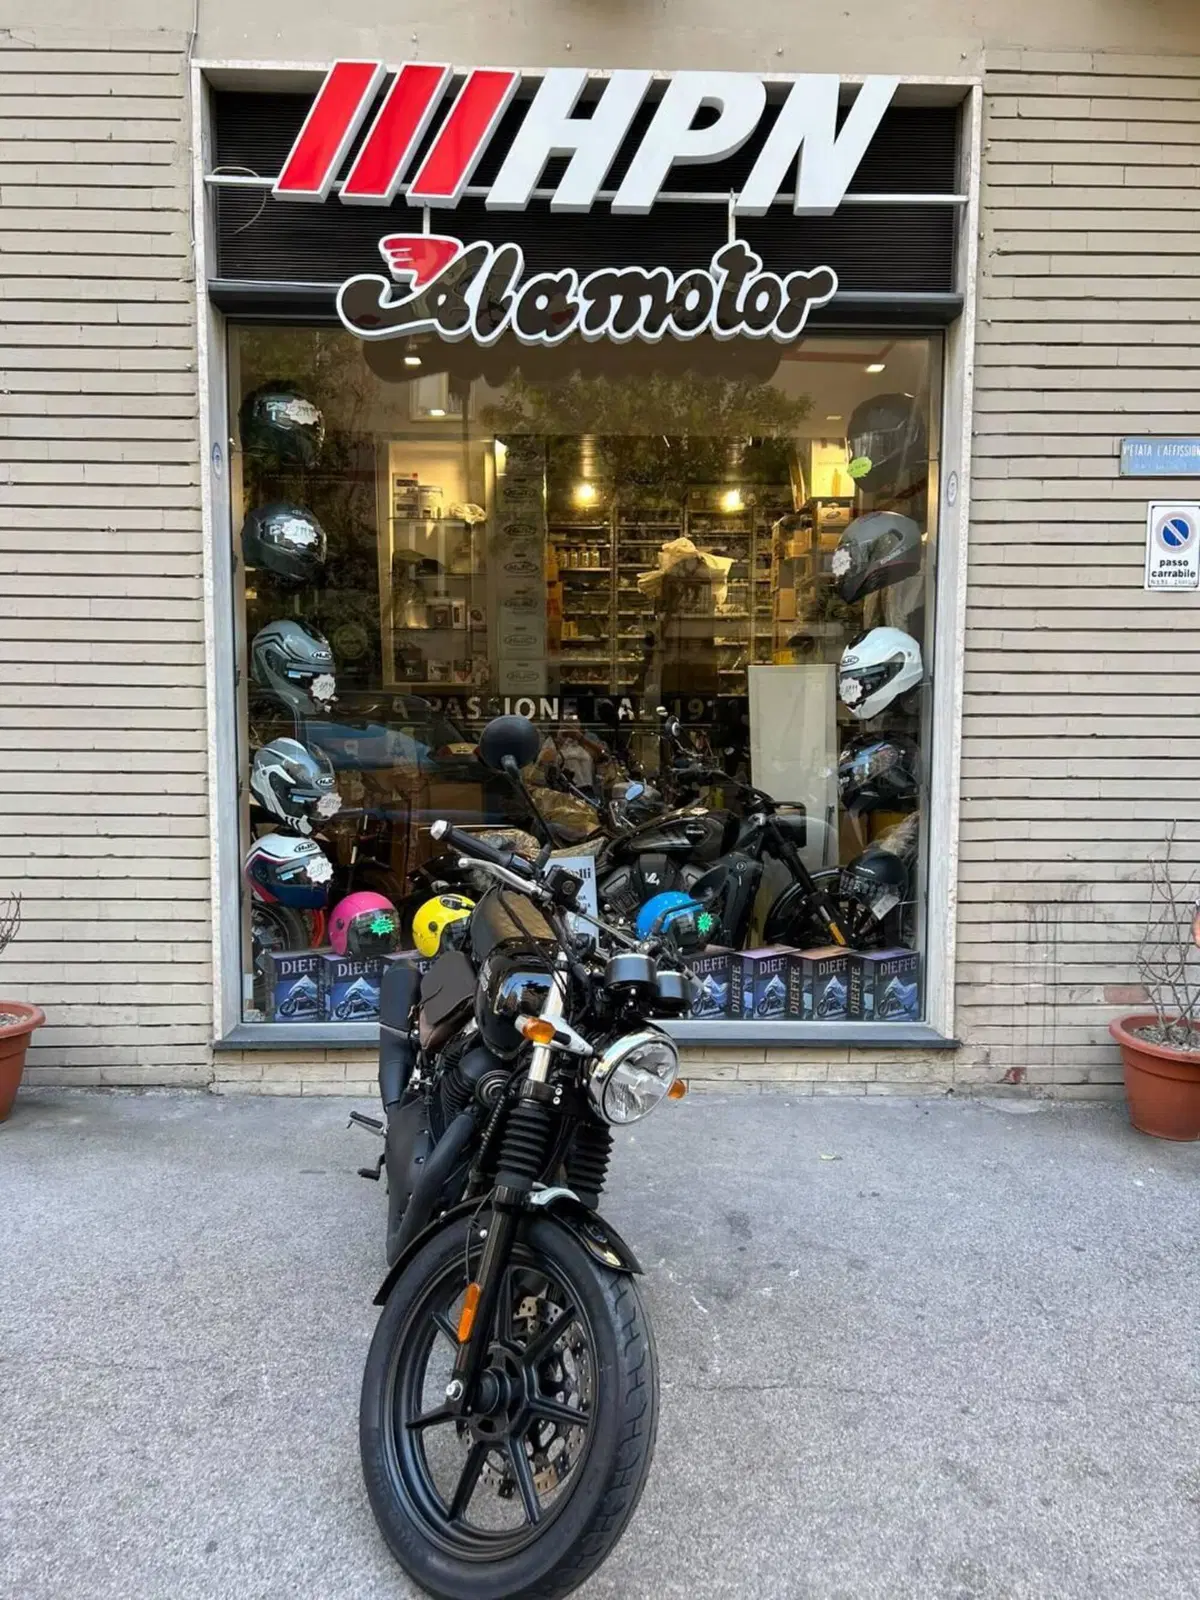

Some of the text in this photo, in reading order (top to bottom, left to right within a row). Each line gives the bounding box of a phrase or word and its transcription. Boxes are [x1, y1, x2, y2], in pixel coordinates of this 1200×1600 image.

[485, 68, 900, 215] HPN
[336, 234, 839, 346] Alamotor
[1151, 569, 1196, 578] carrabile
[1159, 559, 1189, 569] passo
[731, 965, 741, 1013] DIEFFE
[818, 958, 848, 976] DIEFF
[880, 956, 917, 976] DIEFFE
[789, 966, 800, 1014] DIEFFE
[850, 967, 861, 1014] DIEFFE
